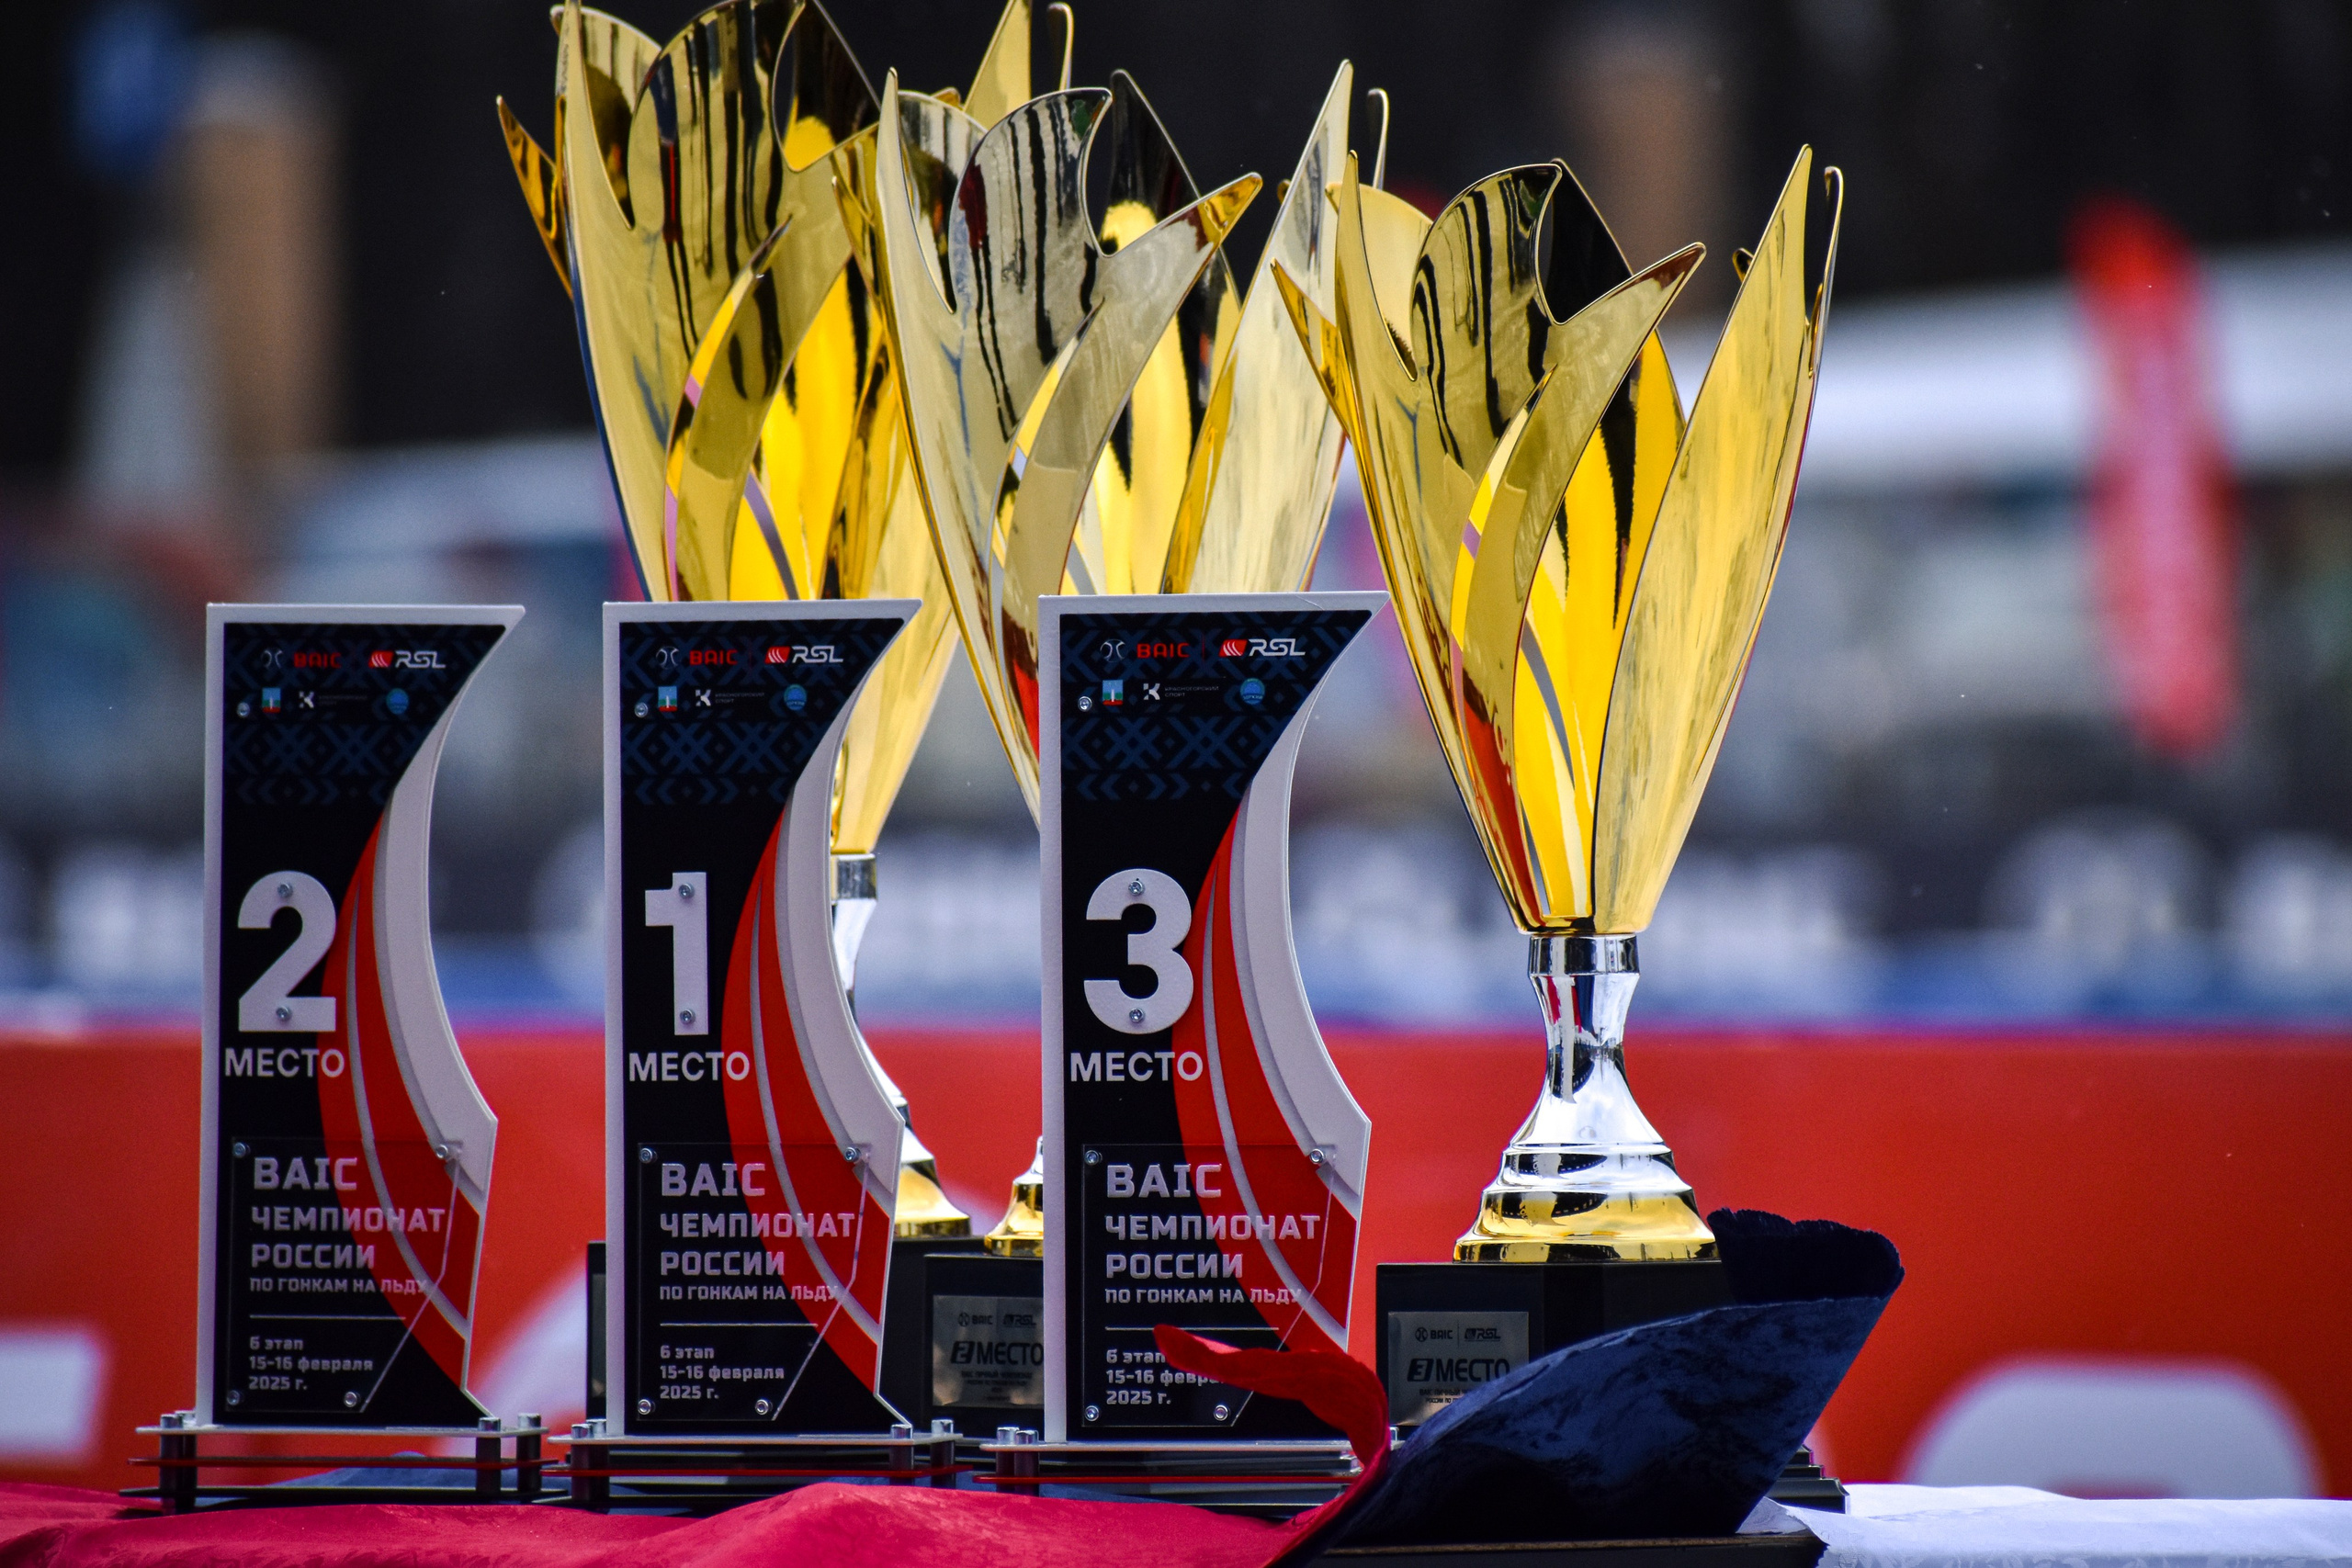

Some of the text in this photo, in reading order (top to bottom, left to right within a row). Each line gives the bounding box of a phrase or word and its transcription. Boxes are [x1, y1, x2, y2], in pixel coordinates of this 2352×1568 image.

[792, 645, 844, 664] RSL
[1136, 643, 1190, 659] BAIC
[1249, 638, 1306, 657] RSL
[294, 652, 342, 668] BAIC
[395, 650, 446, 669] RSL
[689, 649, 738, 666] BAIC
[238, 871, 336, 1032] 2
[645, 872, 708, 1036] 1
[1083, 868, 1194, 1035] 3
[225, 1048, 345, 1077] МЕСТО
[628, 1051, 750, 1082] МЕСТО
[1070, 1051, 1204, 1082] МЕСТО
[254, 1156, 357, 1190] BAIC
[662, 1162, 765, 1197] BAIC
[1106, 1163, 1222, 1199] BAIC
[252, 1206, 446, 1233] ЧЕМПИОНАТ
[660, 1213, 855, 1238] ЧЕМПИОНАТ
[1105, 1215, 1320, 1240] ЧЕМПИОНАТ
[252, 1244, 375, 1269] РОССИИ
[660, 1251, 785, 1276] РОССИИ
[1105, 1253, 1243, 1279] РОССИИ
[250, 1278, 427, 1296] ПО ГОНКАМ НА ЛЬДУ
[660, 1286, 838, 1303] ПО ГОНКАМ НА ЛЬДУ
[1105, 1289, 1302, 1305] ПО ГОНКАМ НА ЛЬДУ
[972, 1314, 993, 1325] BAIC
[1430, 1329, 1453, 1339] BAIC
[1477, 1328, 1501, 1339] RSL
[249, 1336, 304, 1351] 6 этап
[660, 1345, 715, 1359] 6 этап
[977, 1342, 1044, 1366] МЕСТО
[1106, 1348, 1166, 1363] 6 этап
[249, 1356, 373, 1373] 15-16 февраля
[660, 1365, 785, 1382] 15-16 февраля
[1409, 1359, 1510, 1382] 3 МЕСТО
[248, 1376, 307, 1391] 2025 г.
[1106, 1370, 1224, 1386] 15-16 февр
[660, 1385, 718, 1400] 2025 г.
[1106, 1390, 1171, 1404] 2025 г.
